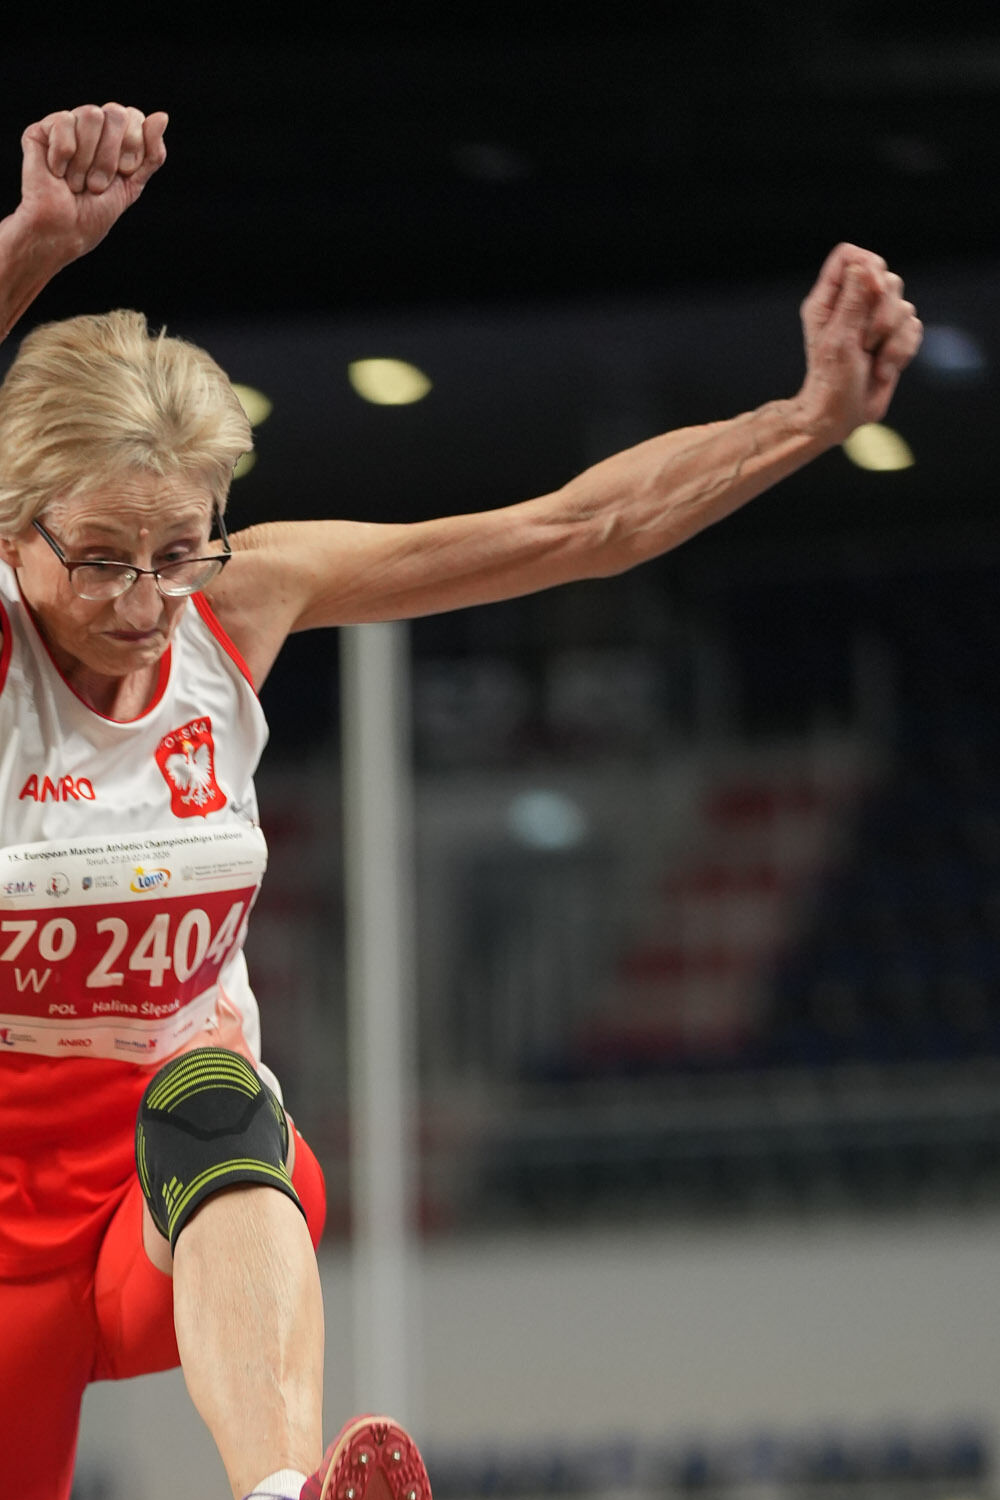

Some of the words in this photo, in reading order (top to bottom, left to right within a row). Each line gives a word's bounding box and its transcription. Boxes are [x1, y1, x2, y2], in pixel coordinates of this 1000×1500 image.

[19, 773, 96, 803] ANRO
[24, 850, 68, 861] European
[69, 846, 104, 857] Masters
[106, 841, 143, 853] Athletics
[144, 834, 212, 849] Championships
[138, 873, 164, 888] LOTTO
[0, 917, 77, 962] 70
[86, 901, 244, 989] 2404
[14, 968, 53, 993] W
[49, 1003, 77, 1016] POL
[92, 1000, 138, 1013] Halina
